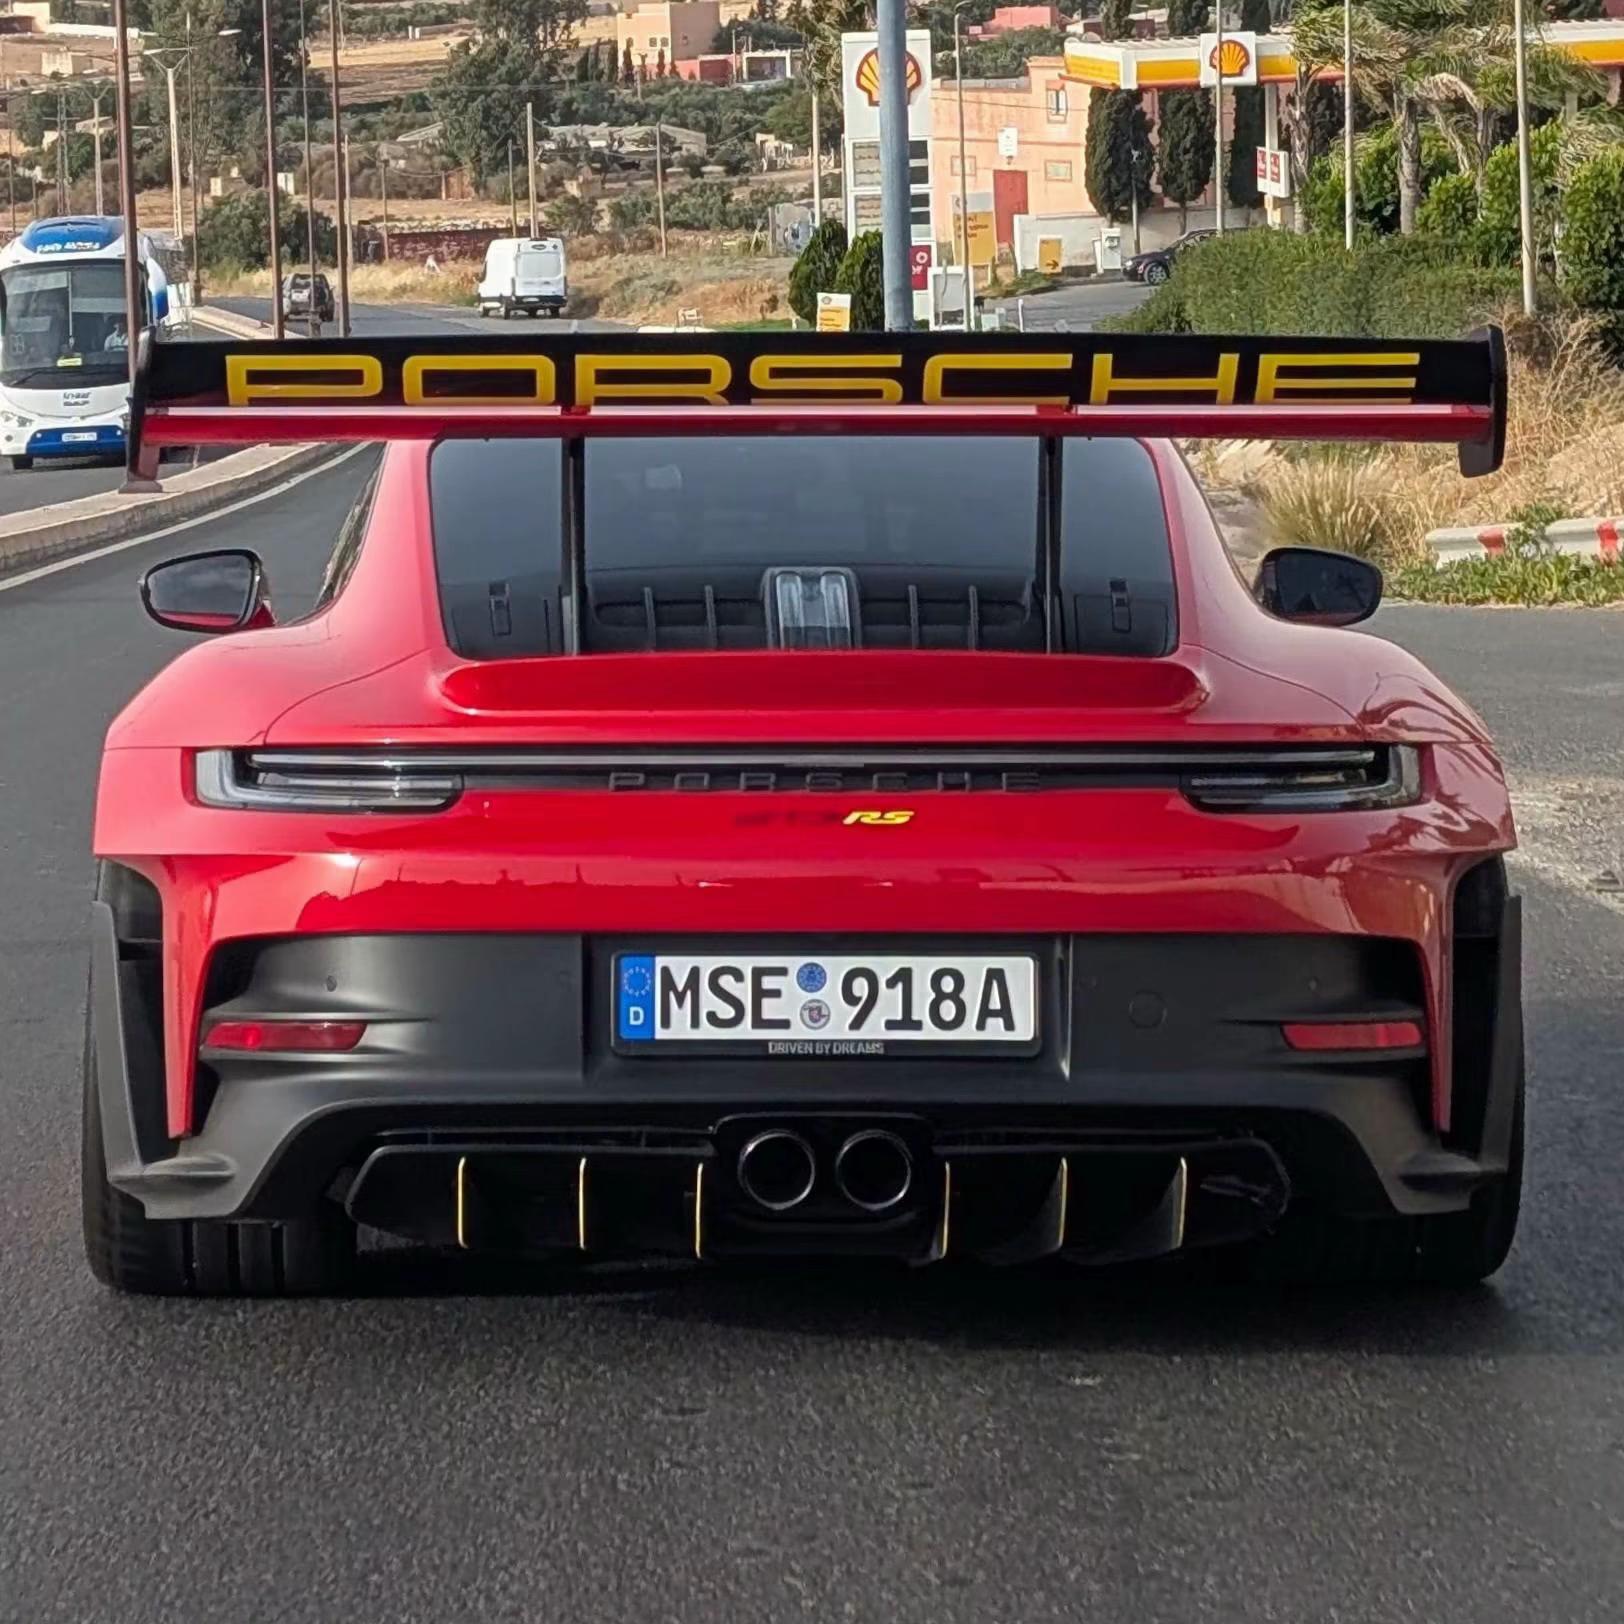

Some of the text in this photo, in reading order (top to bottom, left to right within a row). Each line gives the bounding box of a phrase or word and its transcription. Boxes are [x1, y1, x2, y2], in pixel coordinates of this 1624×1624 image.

[226, 353, 1419, 404] PORSCHE
[608, 771, 1040, 792] PORSCHE
[842, 810, 915, 825] RS
[660, 966, 1016, 1032] MSE 918A
[629, 1006, 644, 1025] D
[767, 1041, 813, 1054] DRIVEN
